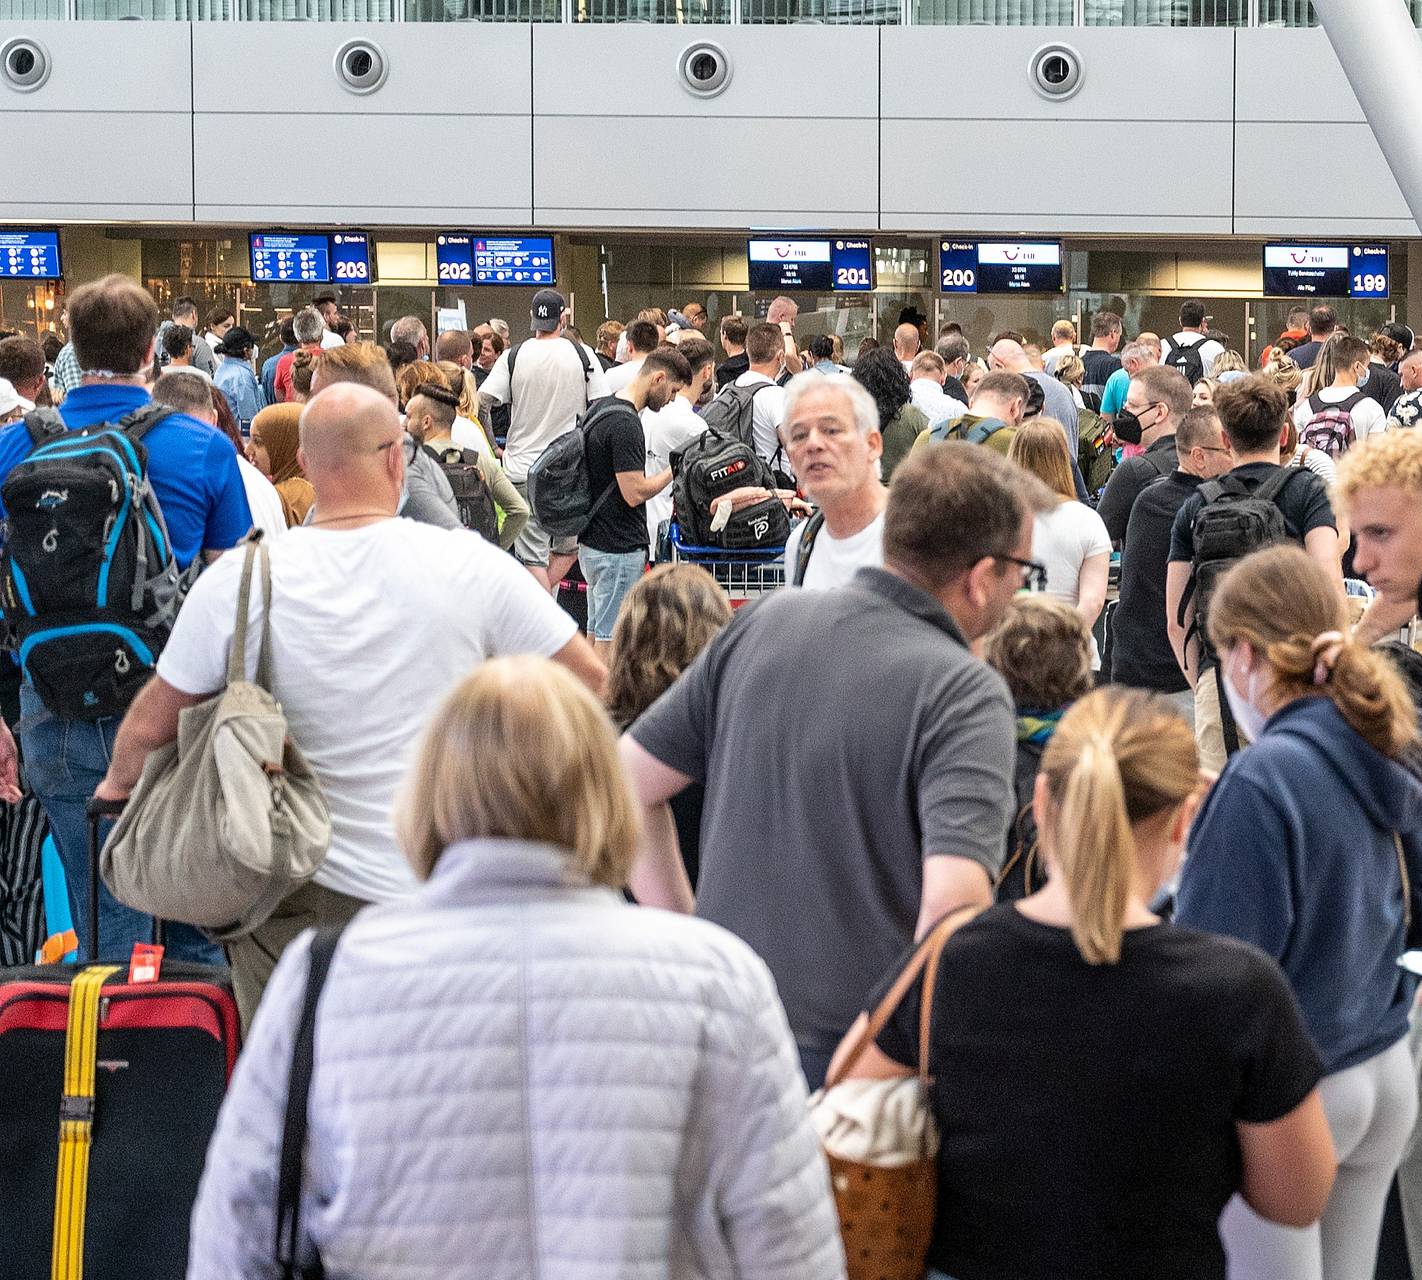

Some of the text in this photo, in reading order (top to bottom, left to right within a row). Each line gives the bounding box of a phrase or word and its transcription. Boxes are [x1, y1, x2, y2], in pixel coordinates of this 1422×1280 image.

[336, 261, 368, 278] 203
[439, 262, 471, 279] 202
[837, 268, 869, 284] 201
[942, 269, 974, 286] 200
[1353, 274, 1386, 292] 199
